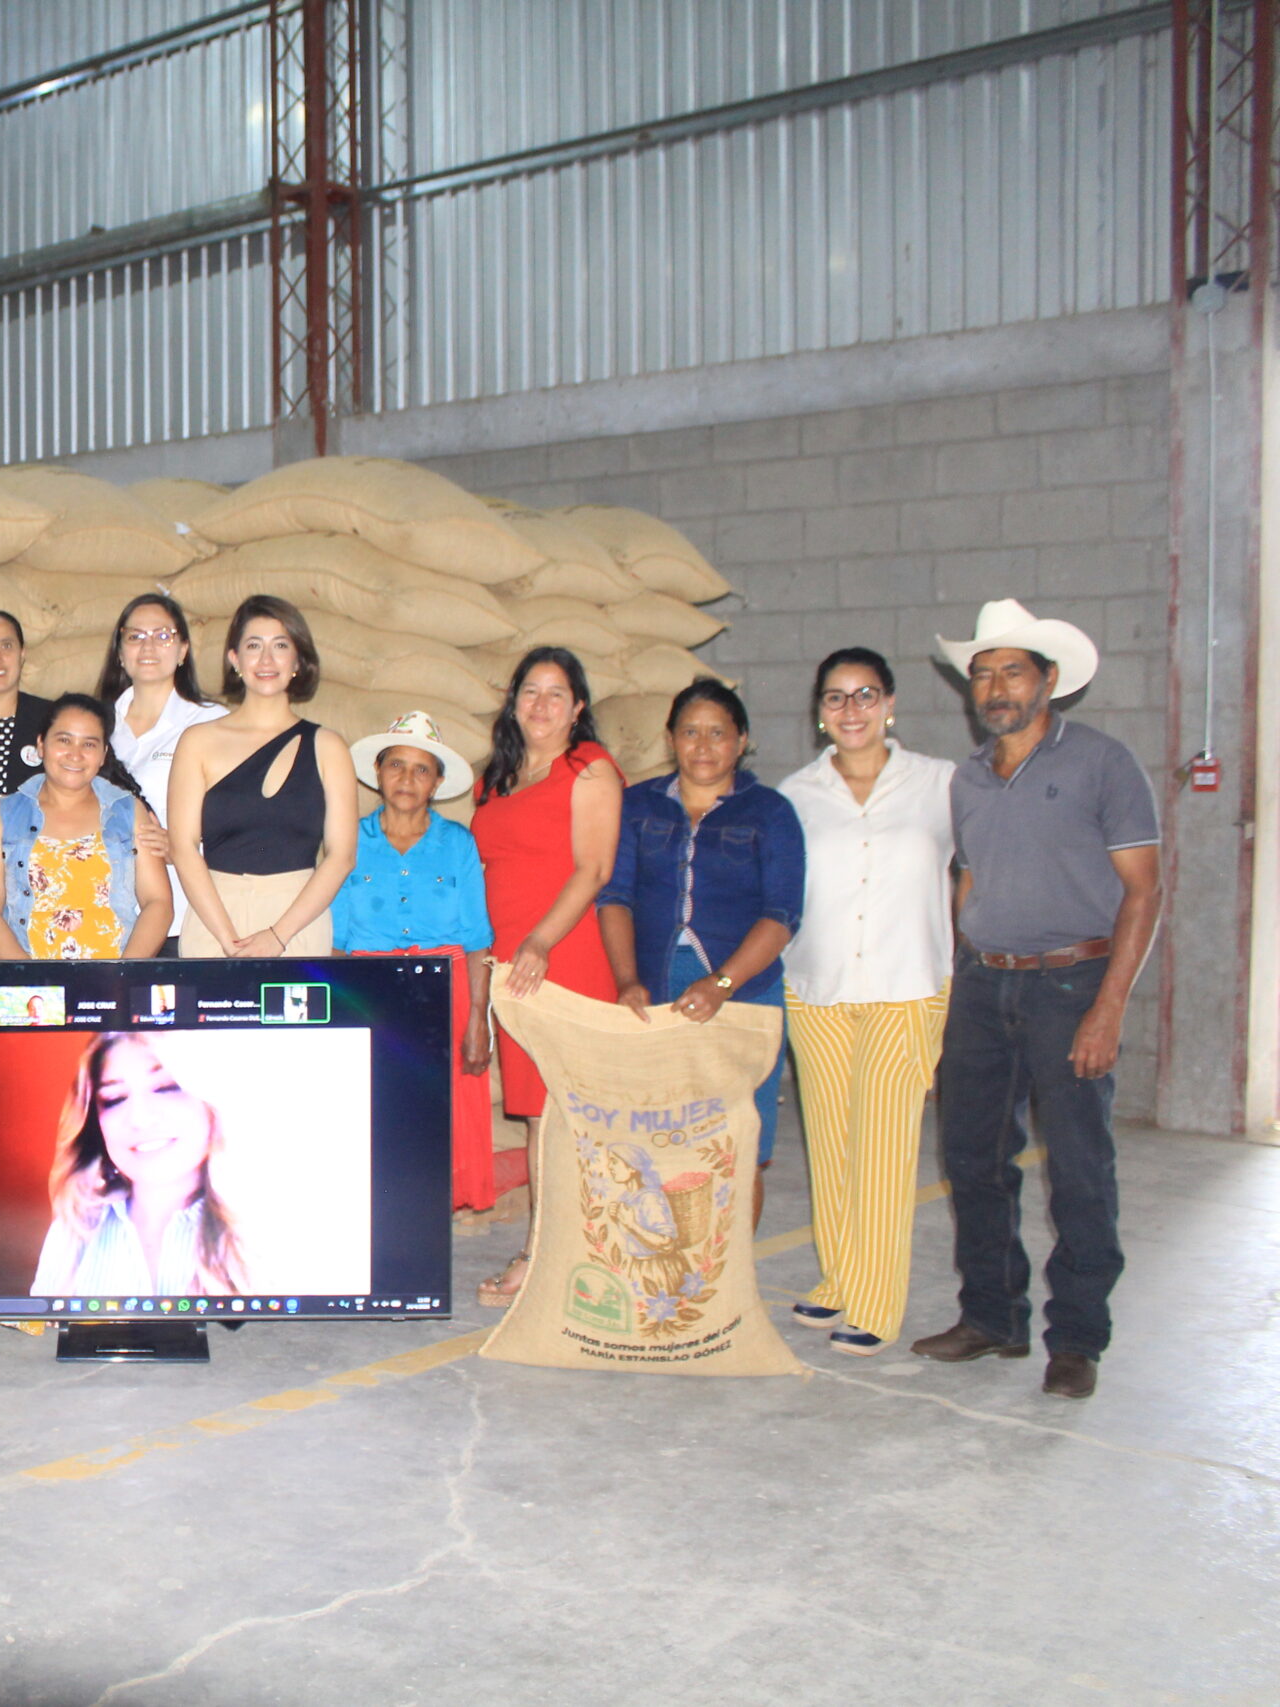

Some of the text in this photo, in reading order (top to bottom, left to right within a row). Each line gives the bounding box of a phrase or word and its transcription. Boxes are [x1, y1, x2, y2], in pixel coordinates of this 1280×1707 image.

[630, 1097, 726, 1132] MUJER
[561, 1326, 601, 1347] Juntas
[603, 1342, 646, 1352] somos
[648, 1338, 700, 1353] mujeres
[702, 1328, 720, 1344] del
